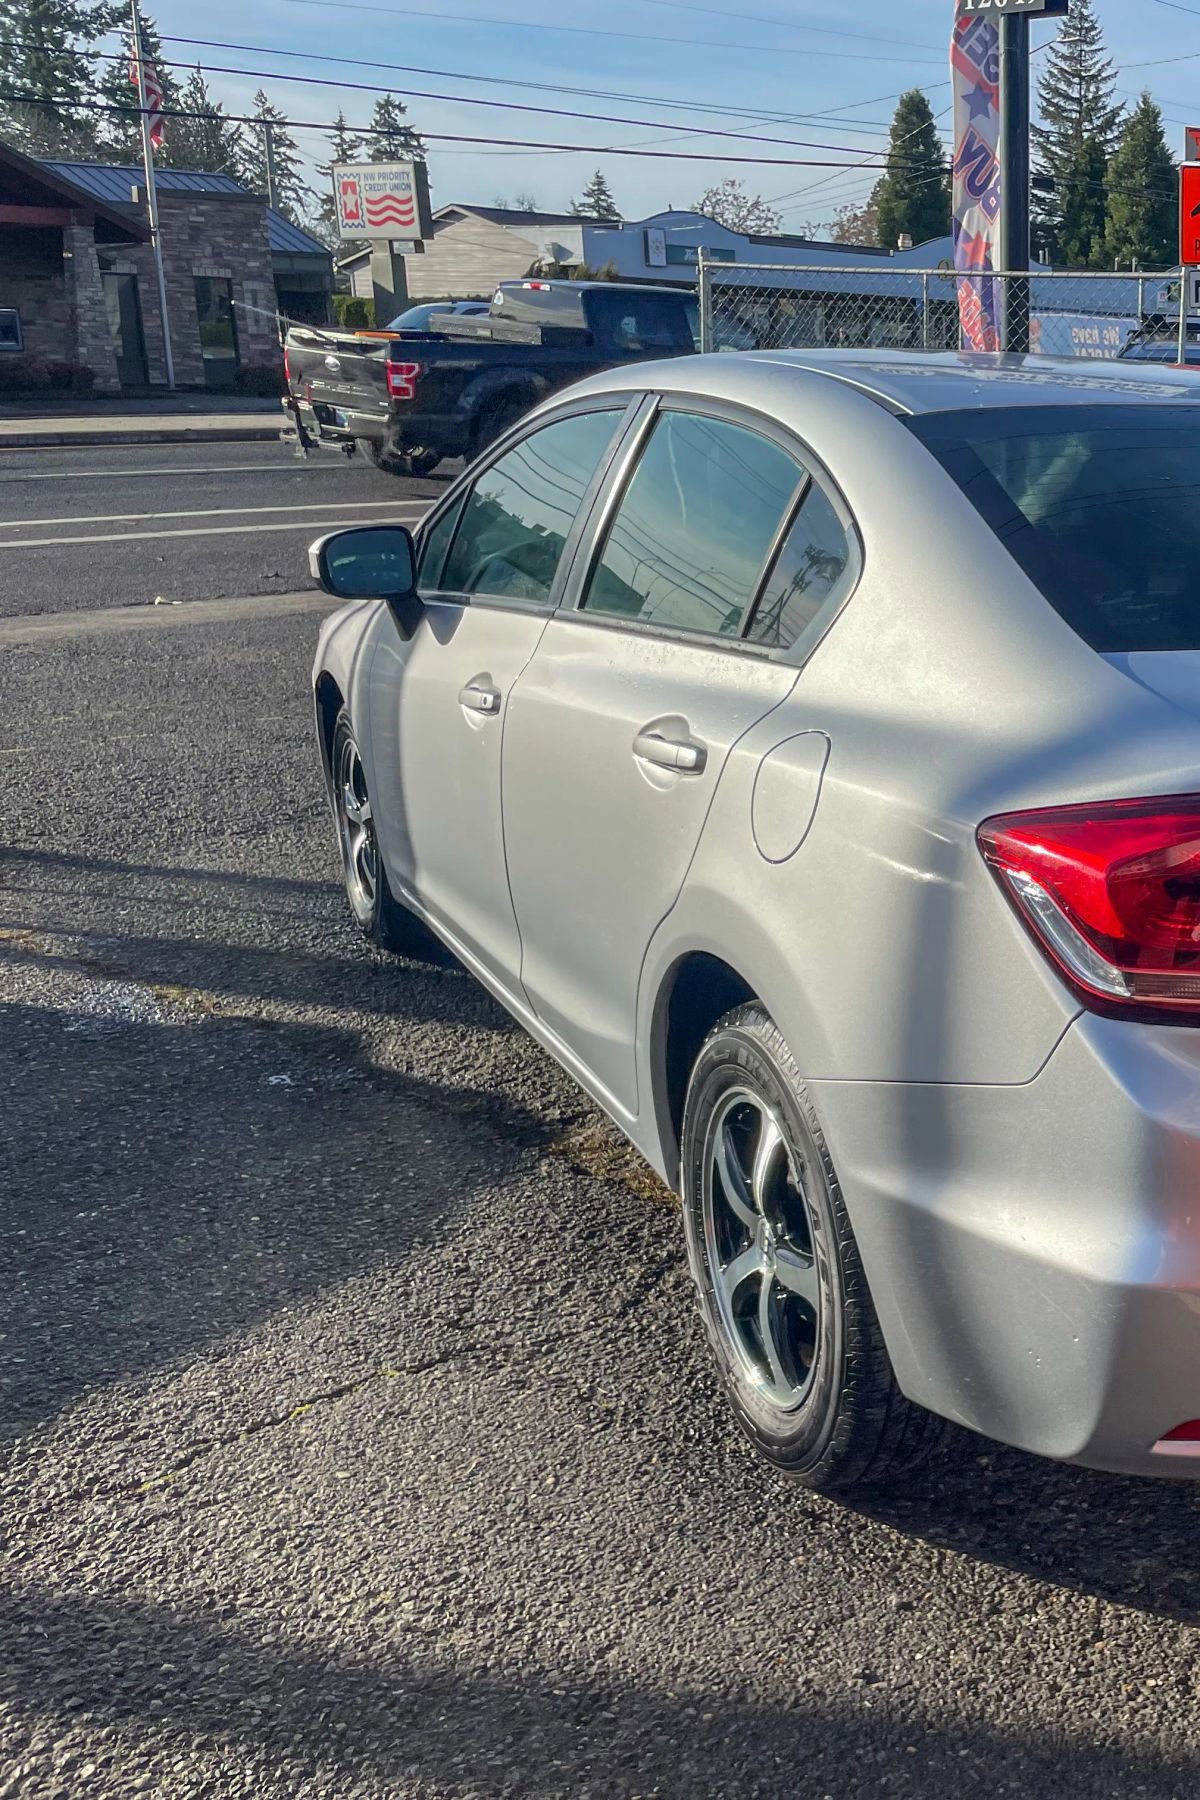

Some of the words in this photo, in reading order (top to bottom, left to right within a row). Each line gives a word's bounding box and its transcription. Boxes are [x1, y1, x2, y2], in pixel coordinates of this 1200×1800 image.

[364, 173, 377, 181] NW
[378, 171, 410, 180] PRIORITY
[364, 183, 387, 192] CREDIT
[389, 182, 412, 191] UNION
